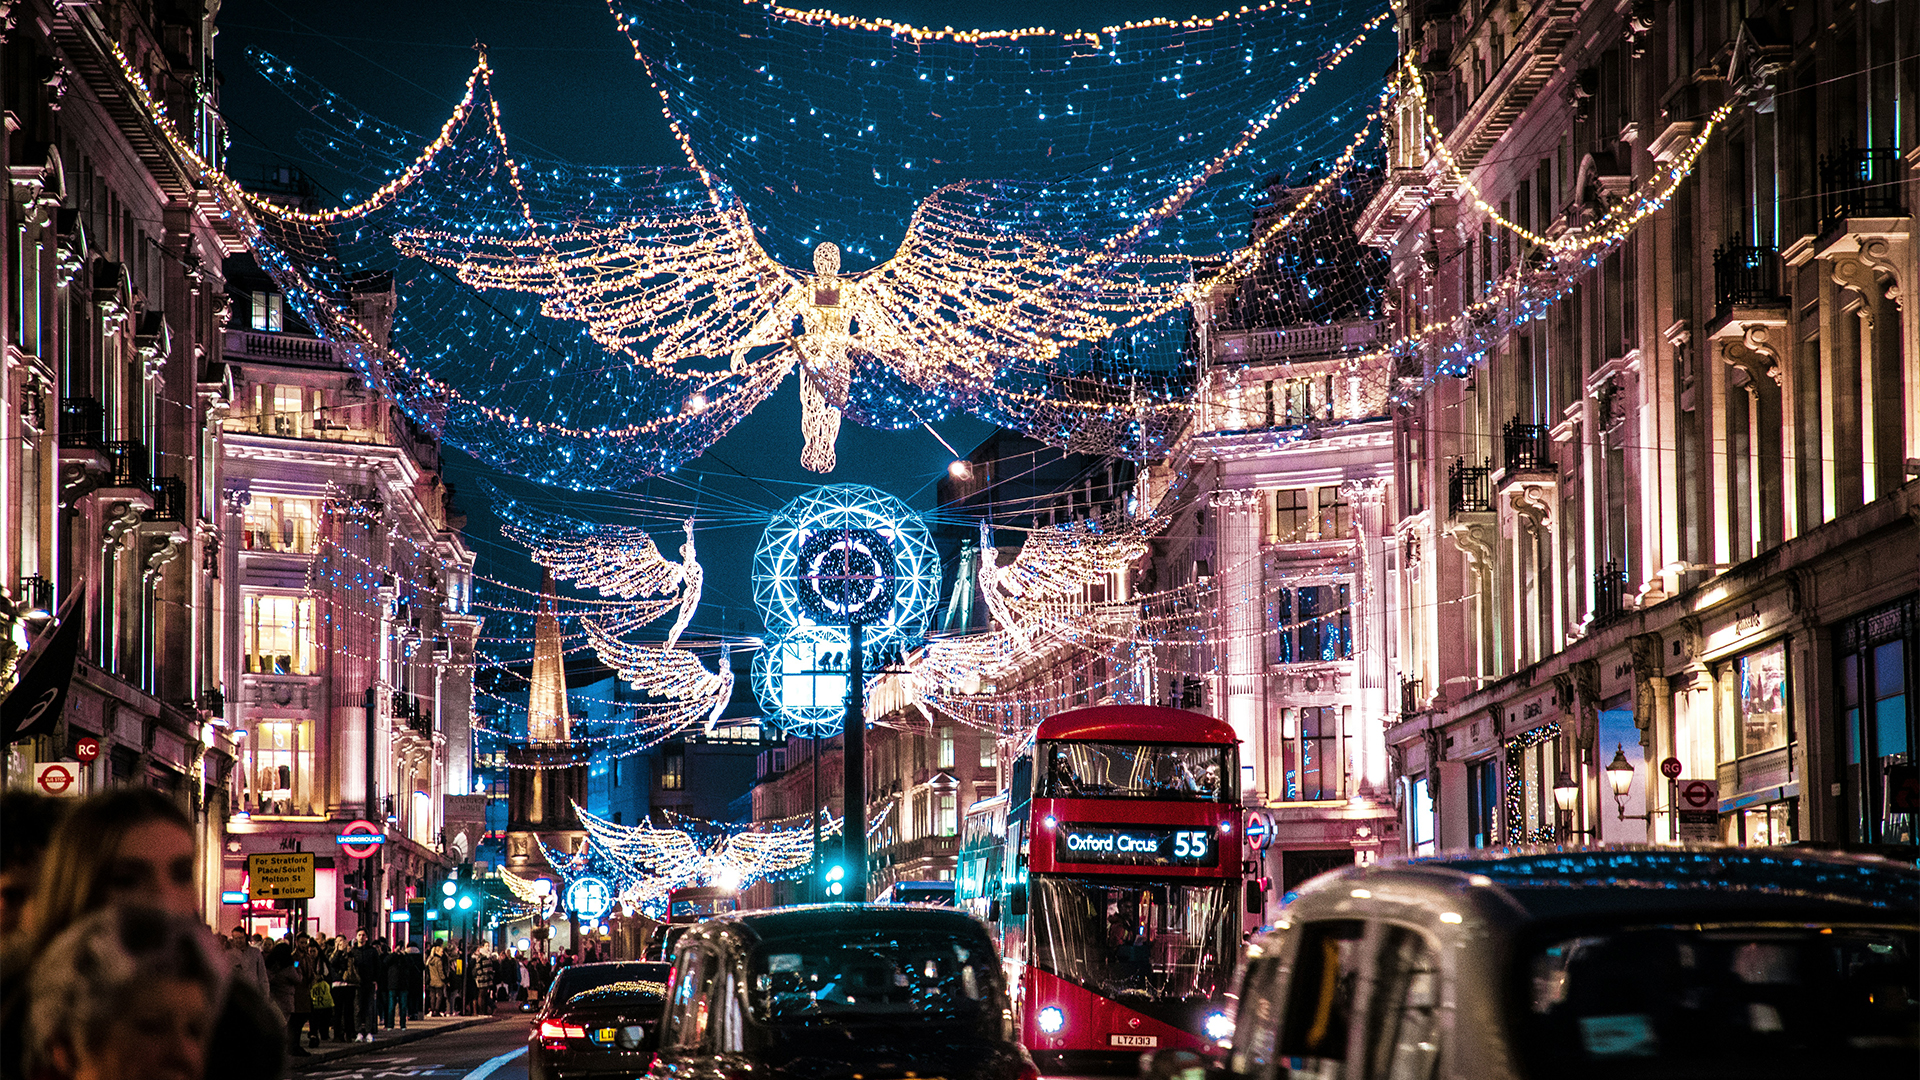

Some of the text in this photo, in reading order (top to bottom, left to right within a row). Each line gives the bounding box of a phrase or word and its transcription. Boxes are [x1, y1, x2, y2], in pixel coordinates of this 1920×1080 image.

[78, 744, 96, 756] RC
[1663, 763, 1680, 773] RG
[1067, 831, 1208, 857] Oxford Circus 55
[270, 856, 308, 865] Stratford
[257, 865, 306, 874] Place/South
[261, 874, 301, 883] Molton St
